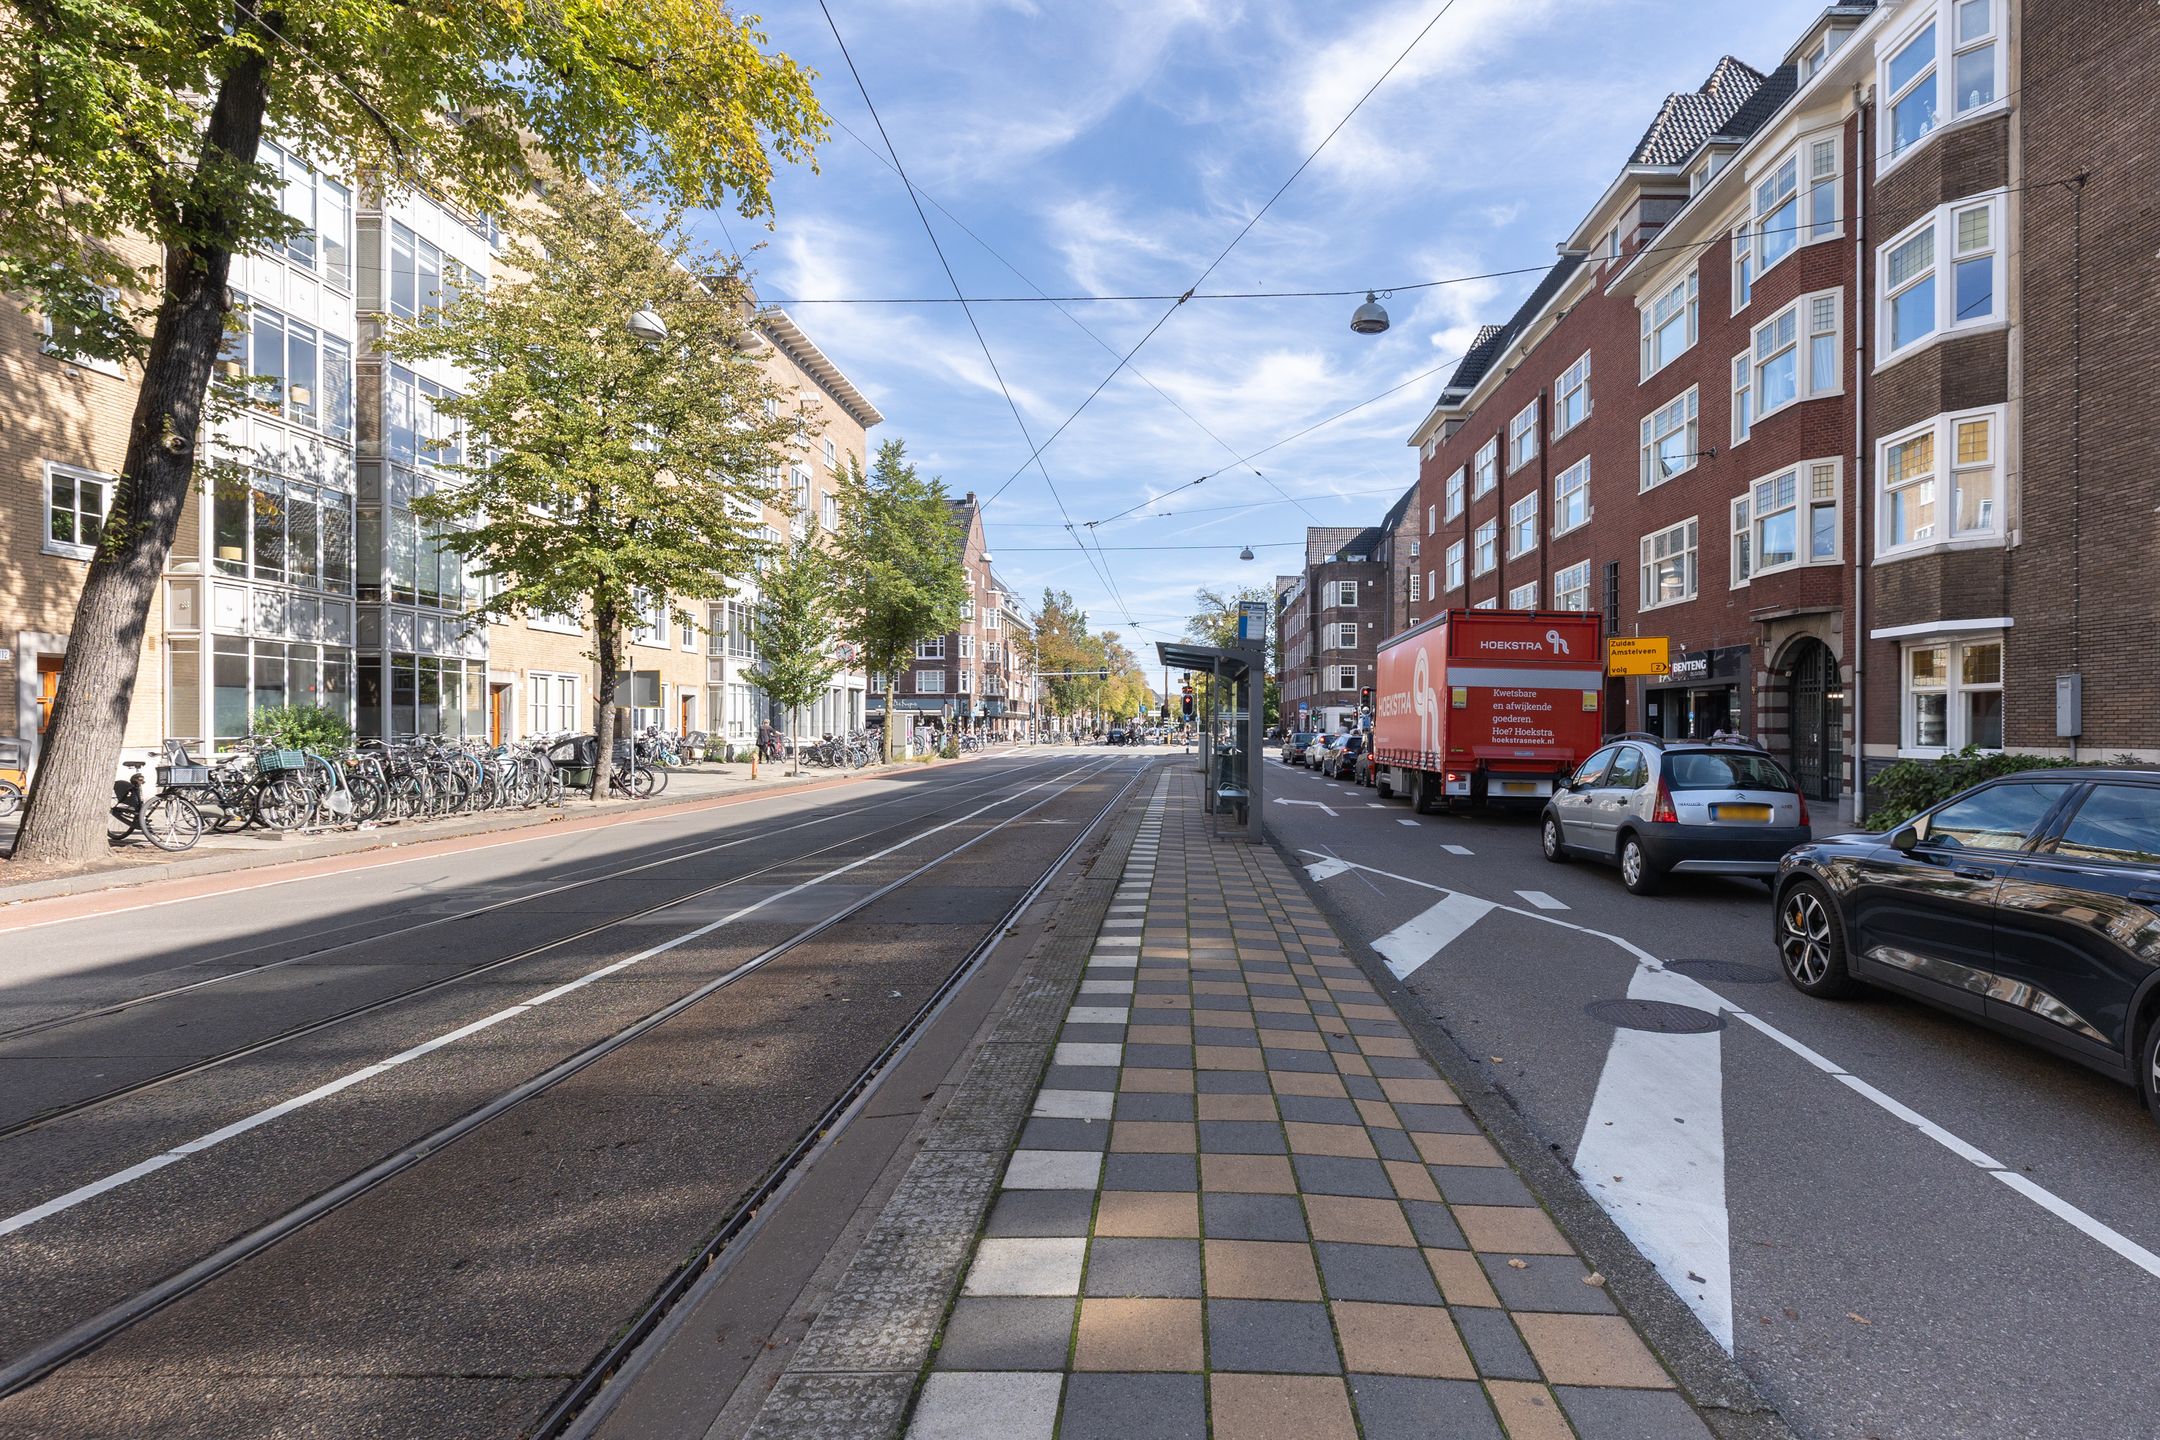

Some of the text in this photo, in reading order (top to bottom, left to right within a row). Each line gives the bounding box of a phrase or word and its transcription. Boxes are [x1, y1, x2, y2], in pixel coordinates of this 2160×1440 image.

[1480, 641, 1542, 650] HOEKSTRA
[1611, 648, 1656, 656] Amstelveen
[1673, 659, 1706, 673] BENTENG
[1493, 688, 1537, 698] Kwetsbare
[1378, 691, 1412, 717] HOEKSTRA
[1505, 702, 1552, 712] afwijkende
[1492, 714, 1533, 724] goederen.
[1492, 727, 1555, 737] Hoe? Hoekstra.
[1491, 736, 1555, 745] hoekstrasneek.nl
